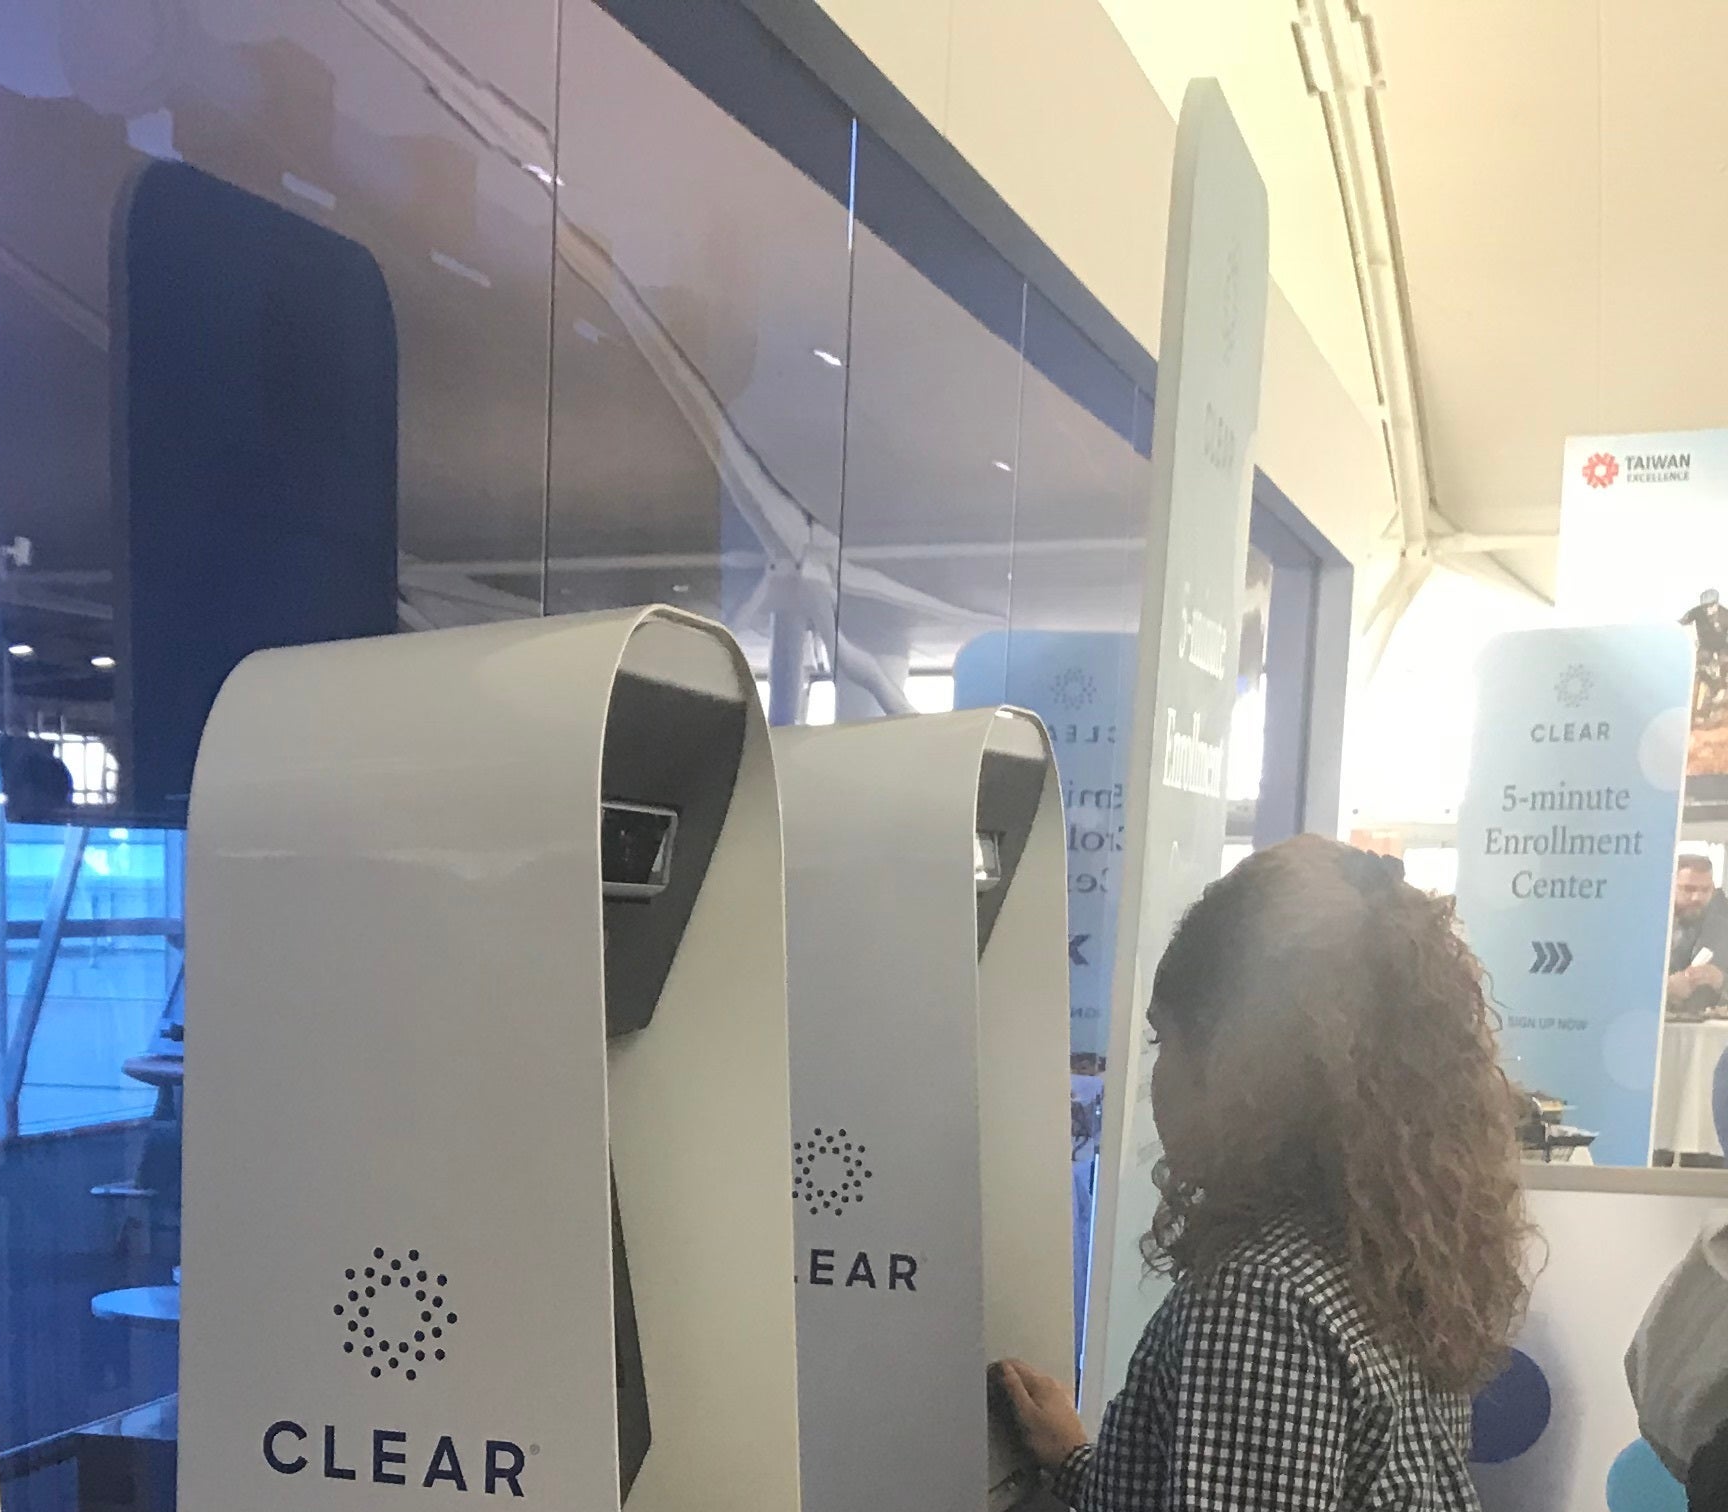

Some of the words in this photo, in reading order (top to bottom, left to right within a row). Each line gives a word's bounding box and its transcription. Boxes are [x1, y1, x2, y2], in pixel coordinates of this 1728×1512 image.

[1625, 453, 1691, 471] TAIWAN
[1626, 471, 1690, 483] EXCELLENCE
[1530, 722, 1611, 743] CLEAR
[1501, 780, 1630, 812] 5-minute
[1483, 824, 1644, 856] Enrollment
[1510, 870, 1608, 899] Center
[1538, 1017, 1556, 1030] UP
[1558, 1018, 1589, 1031] NOW
[794, 1248, 918, 1292] EAR
